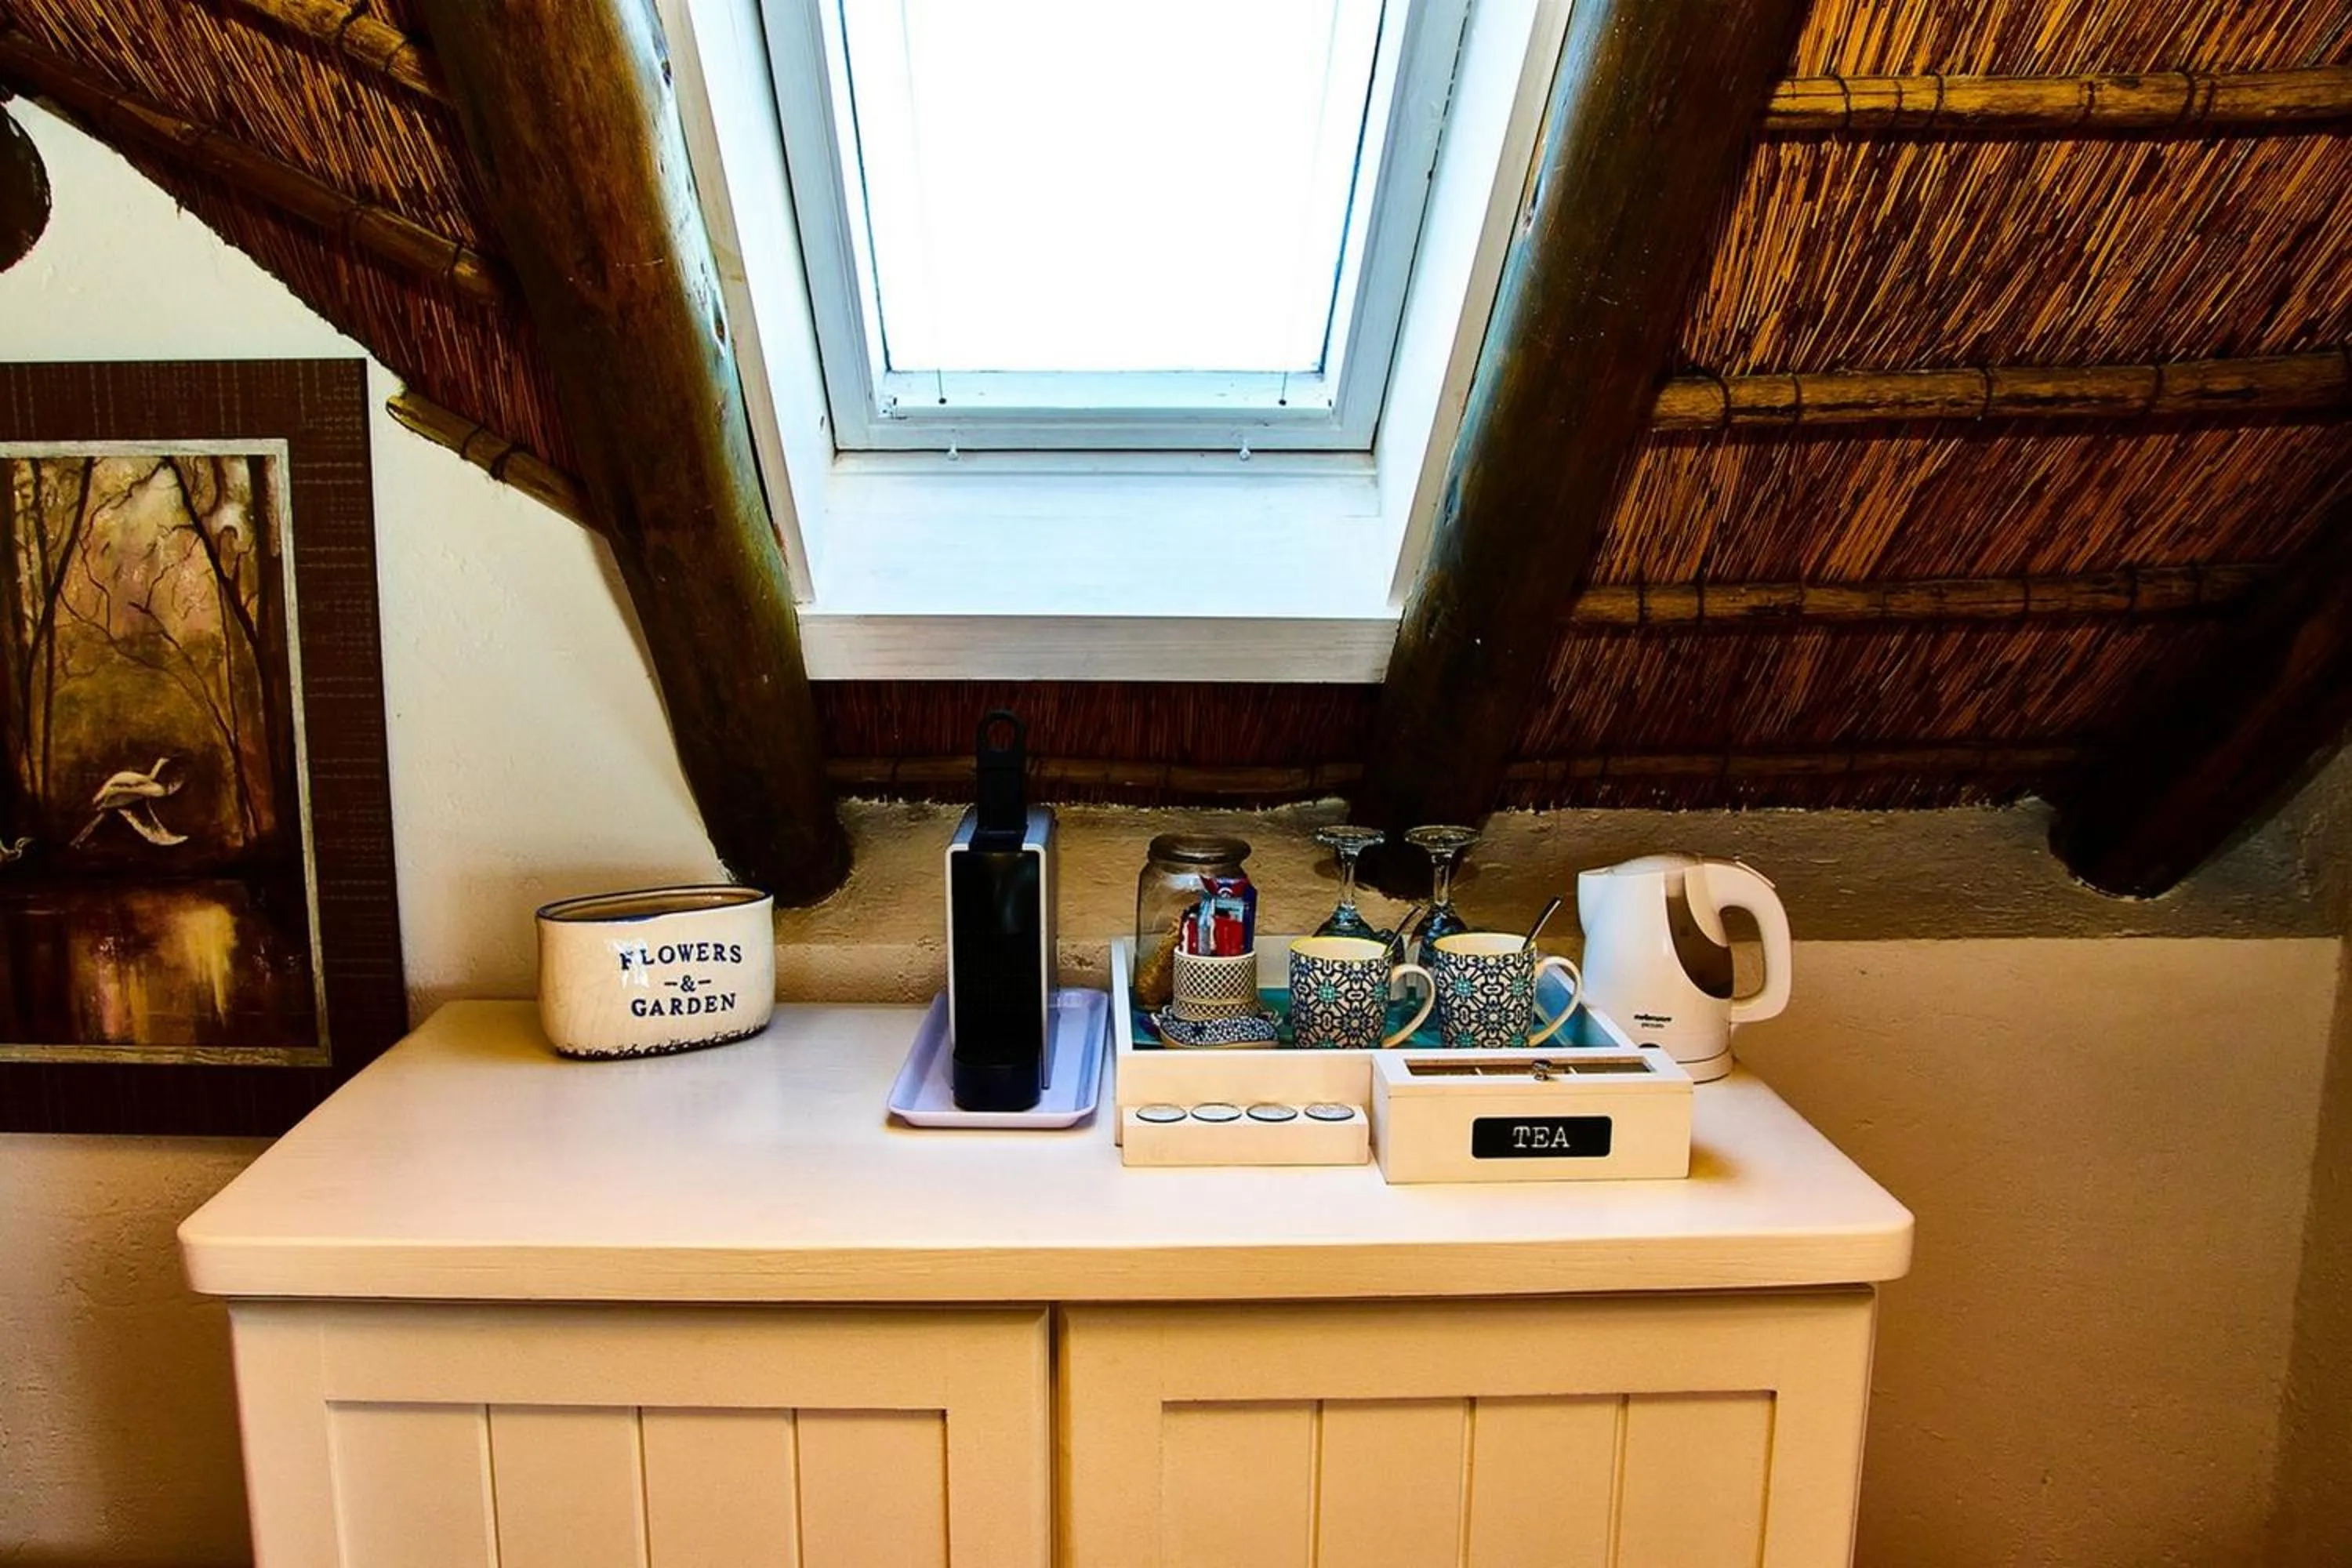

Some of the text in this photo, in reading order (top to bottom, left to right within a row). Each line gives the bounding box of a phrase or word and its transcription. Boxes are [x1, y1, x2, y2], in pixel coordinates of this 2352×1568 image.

[619, 942, 742, 971] FLOWERS
[631, 993, 735, 1016] GARDEN
[1512, 1126, 1570, 1148] TEA
